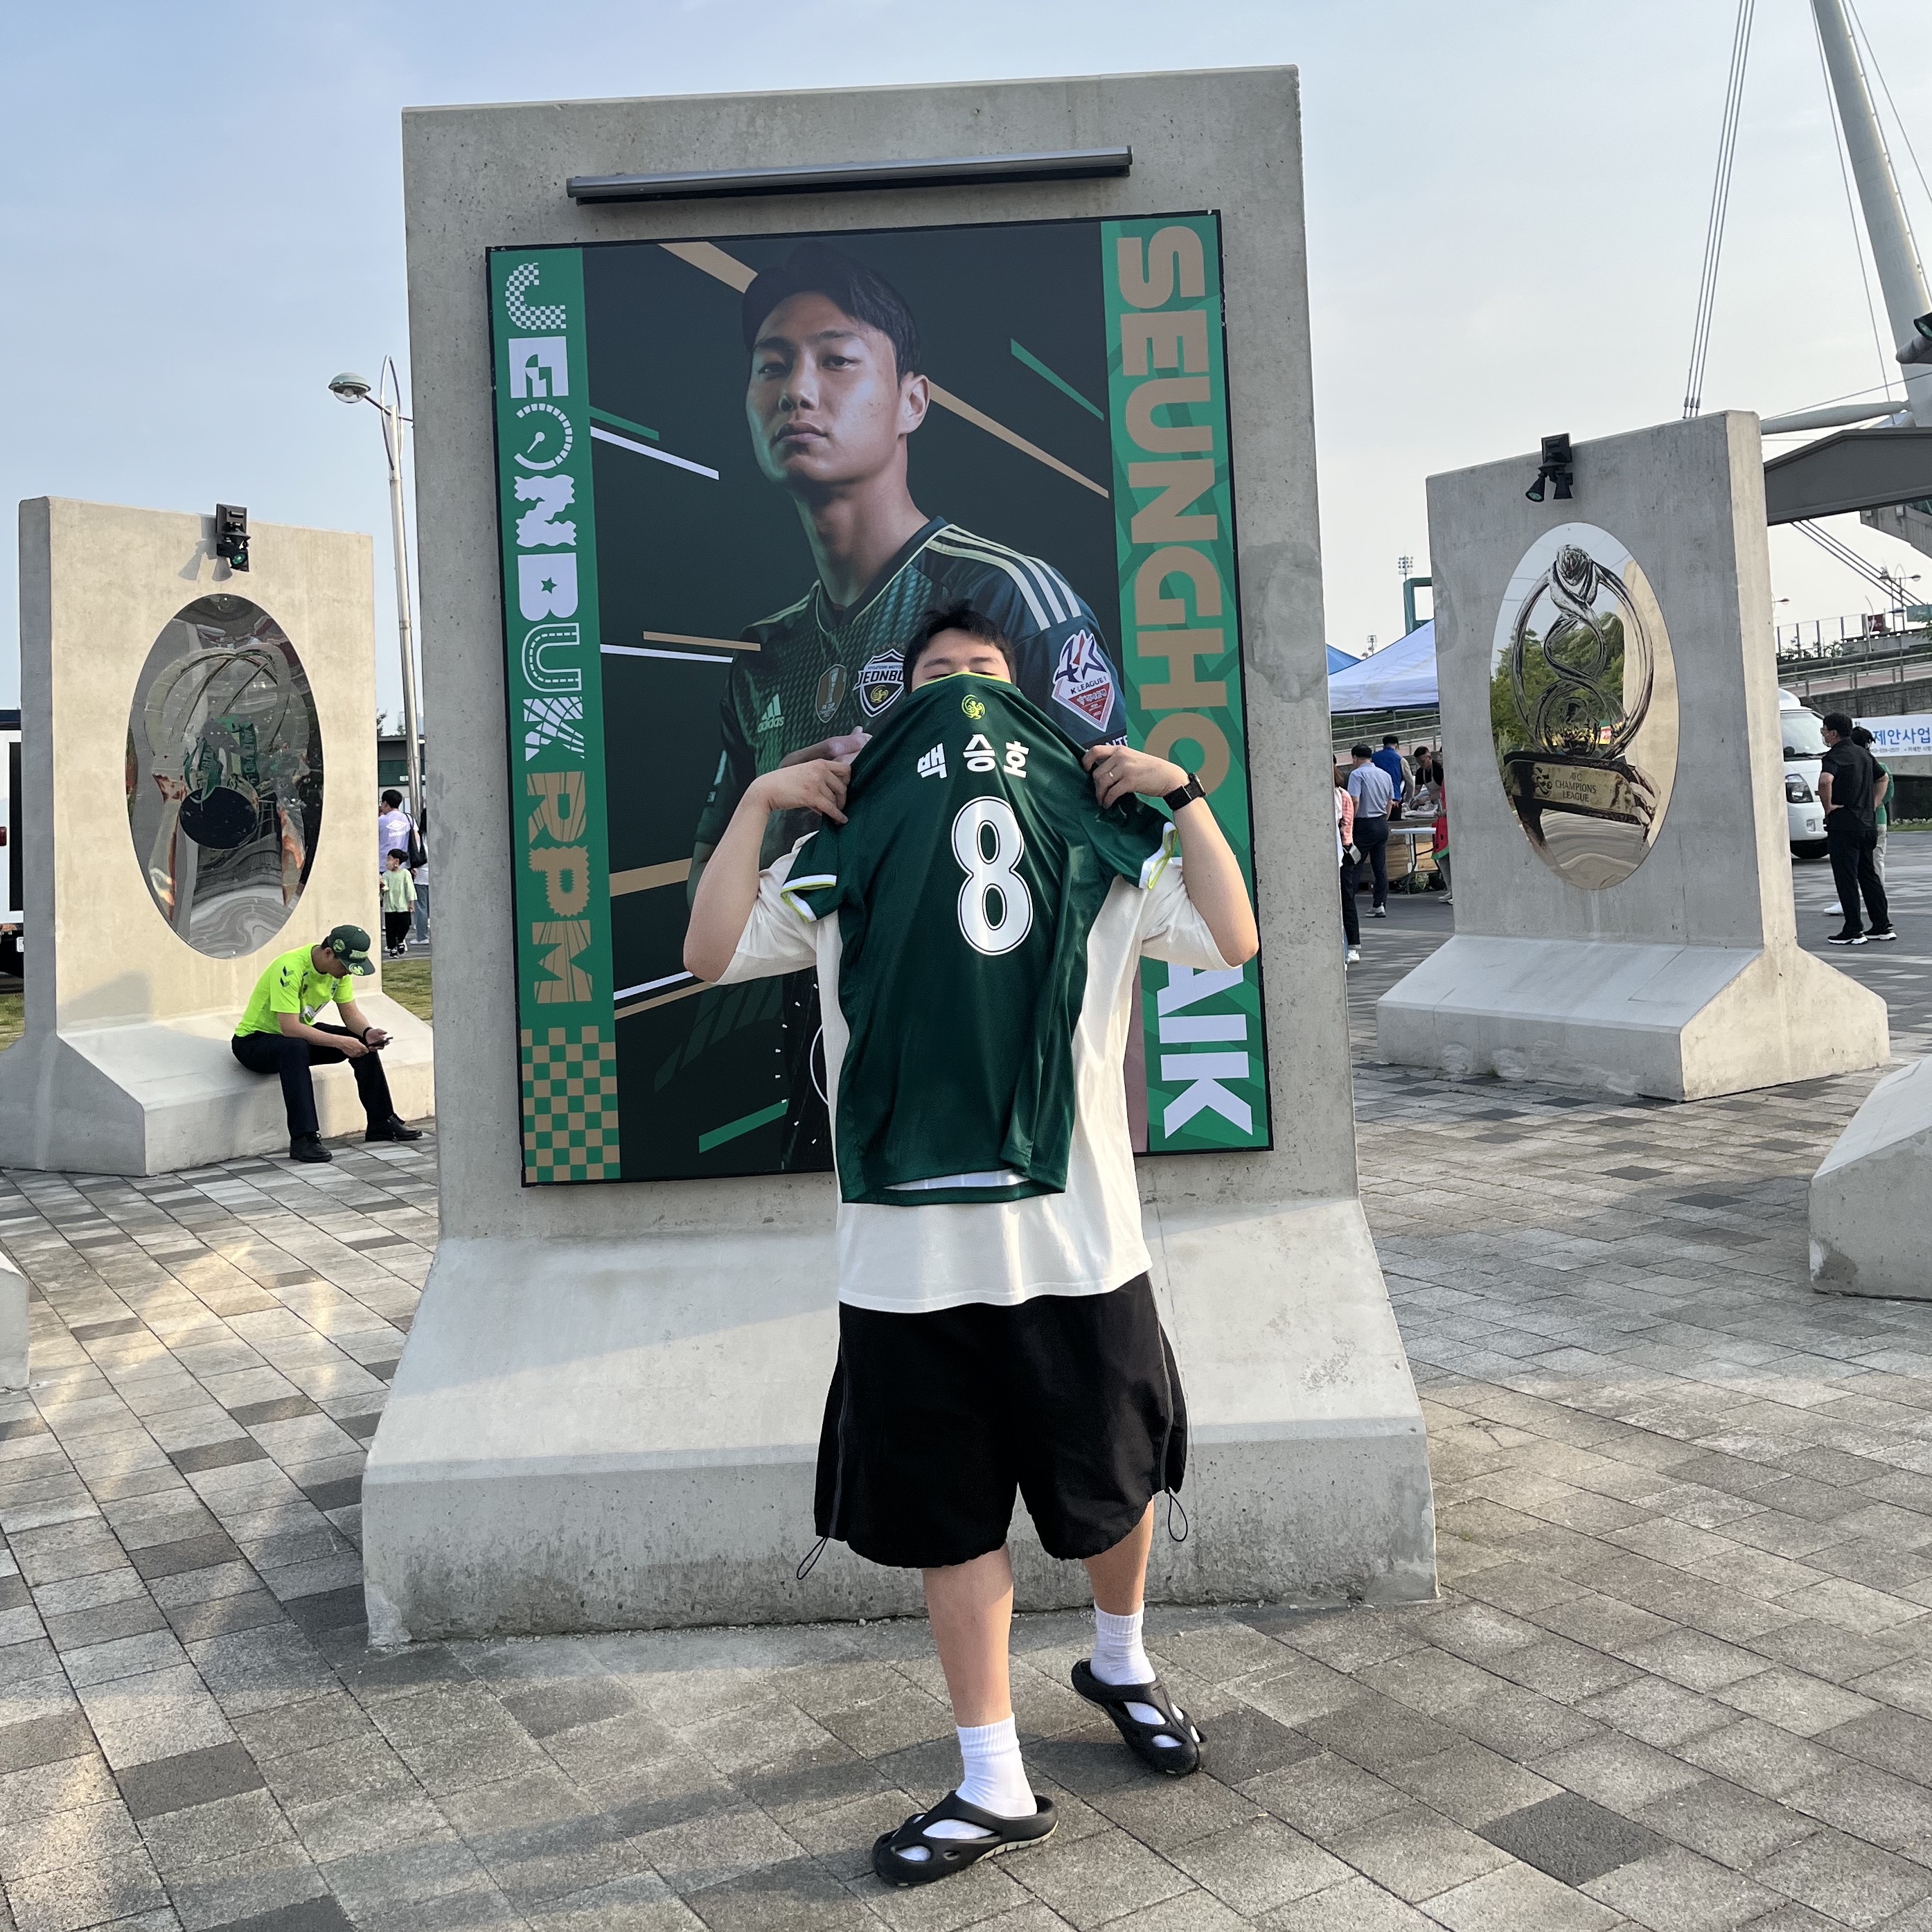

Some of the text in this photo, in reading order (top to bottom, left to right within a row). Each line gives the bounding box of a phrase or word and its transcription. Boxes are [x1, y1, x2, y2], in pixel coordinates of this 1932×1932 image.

[1116, 224, 1230, 795] SEUNGHO
[505, 262, 593, 1004] JEONBUK RPM
[1077, 677, 1104, 692] LEAGUE
[1569, 772, 1582, 781] AFC
[1554, 779, 1597, 794] CHAMPIONS
[1562, 791, 1589, 802] LEAGUE
[951, 796, 1033, 956] 8
